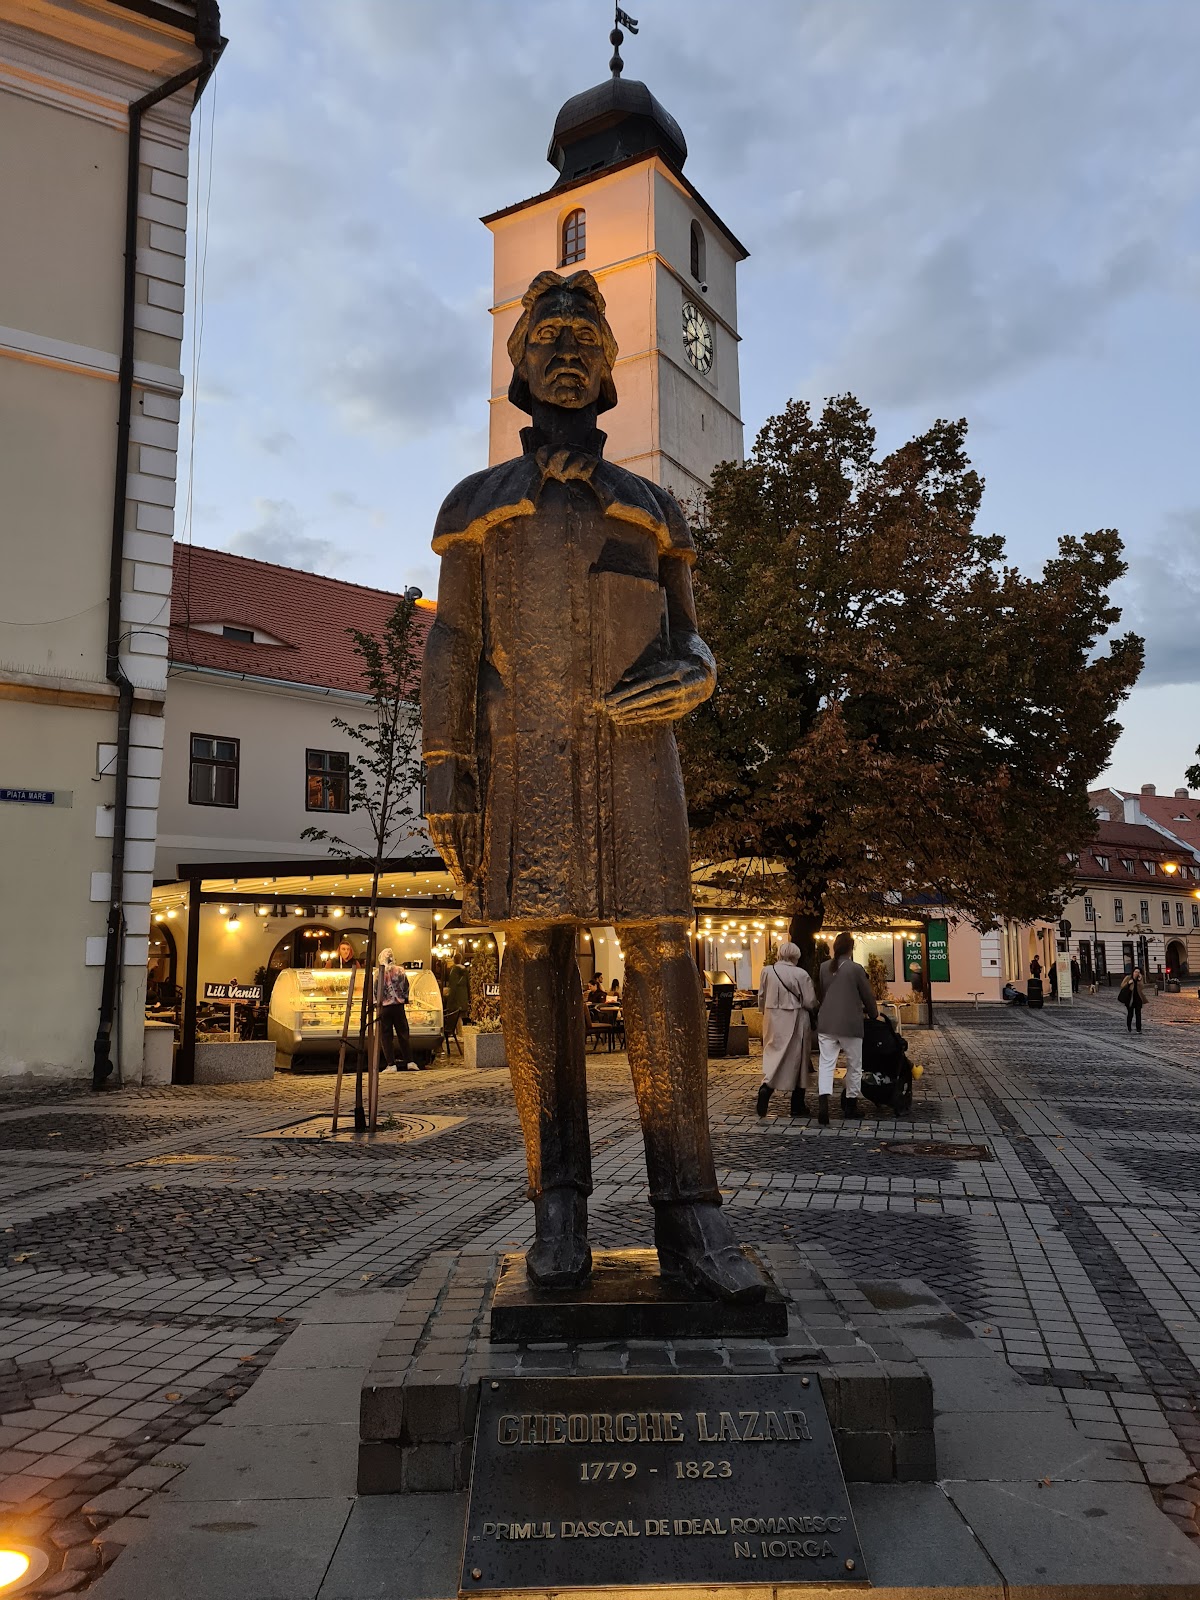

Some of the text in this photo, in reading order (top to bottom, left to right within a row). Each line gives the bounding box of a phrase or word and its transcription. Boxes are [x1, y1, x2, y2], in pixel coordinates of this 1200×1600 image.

[28, 792, 46, 800] MARE
[906, 940, 946, 948] Proram
[206, 985, 260, 998] Lili Vanili
[486, 985, 500, 996] Lili
[497, 1410, 813, 1446] GHEORGHE LAZAR
[580, 1461, 638, 1481] 1779
[675, 1461, 733, 1479] 1823
[560, 1520, 640, 1539] DASCAL
[645, 1519, 669, 1537] DE
[673, 1518, 727, 1537] IDEAL
[734, 1540, 838, 1559] N. IORGA
